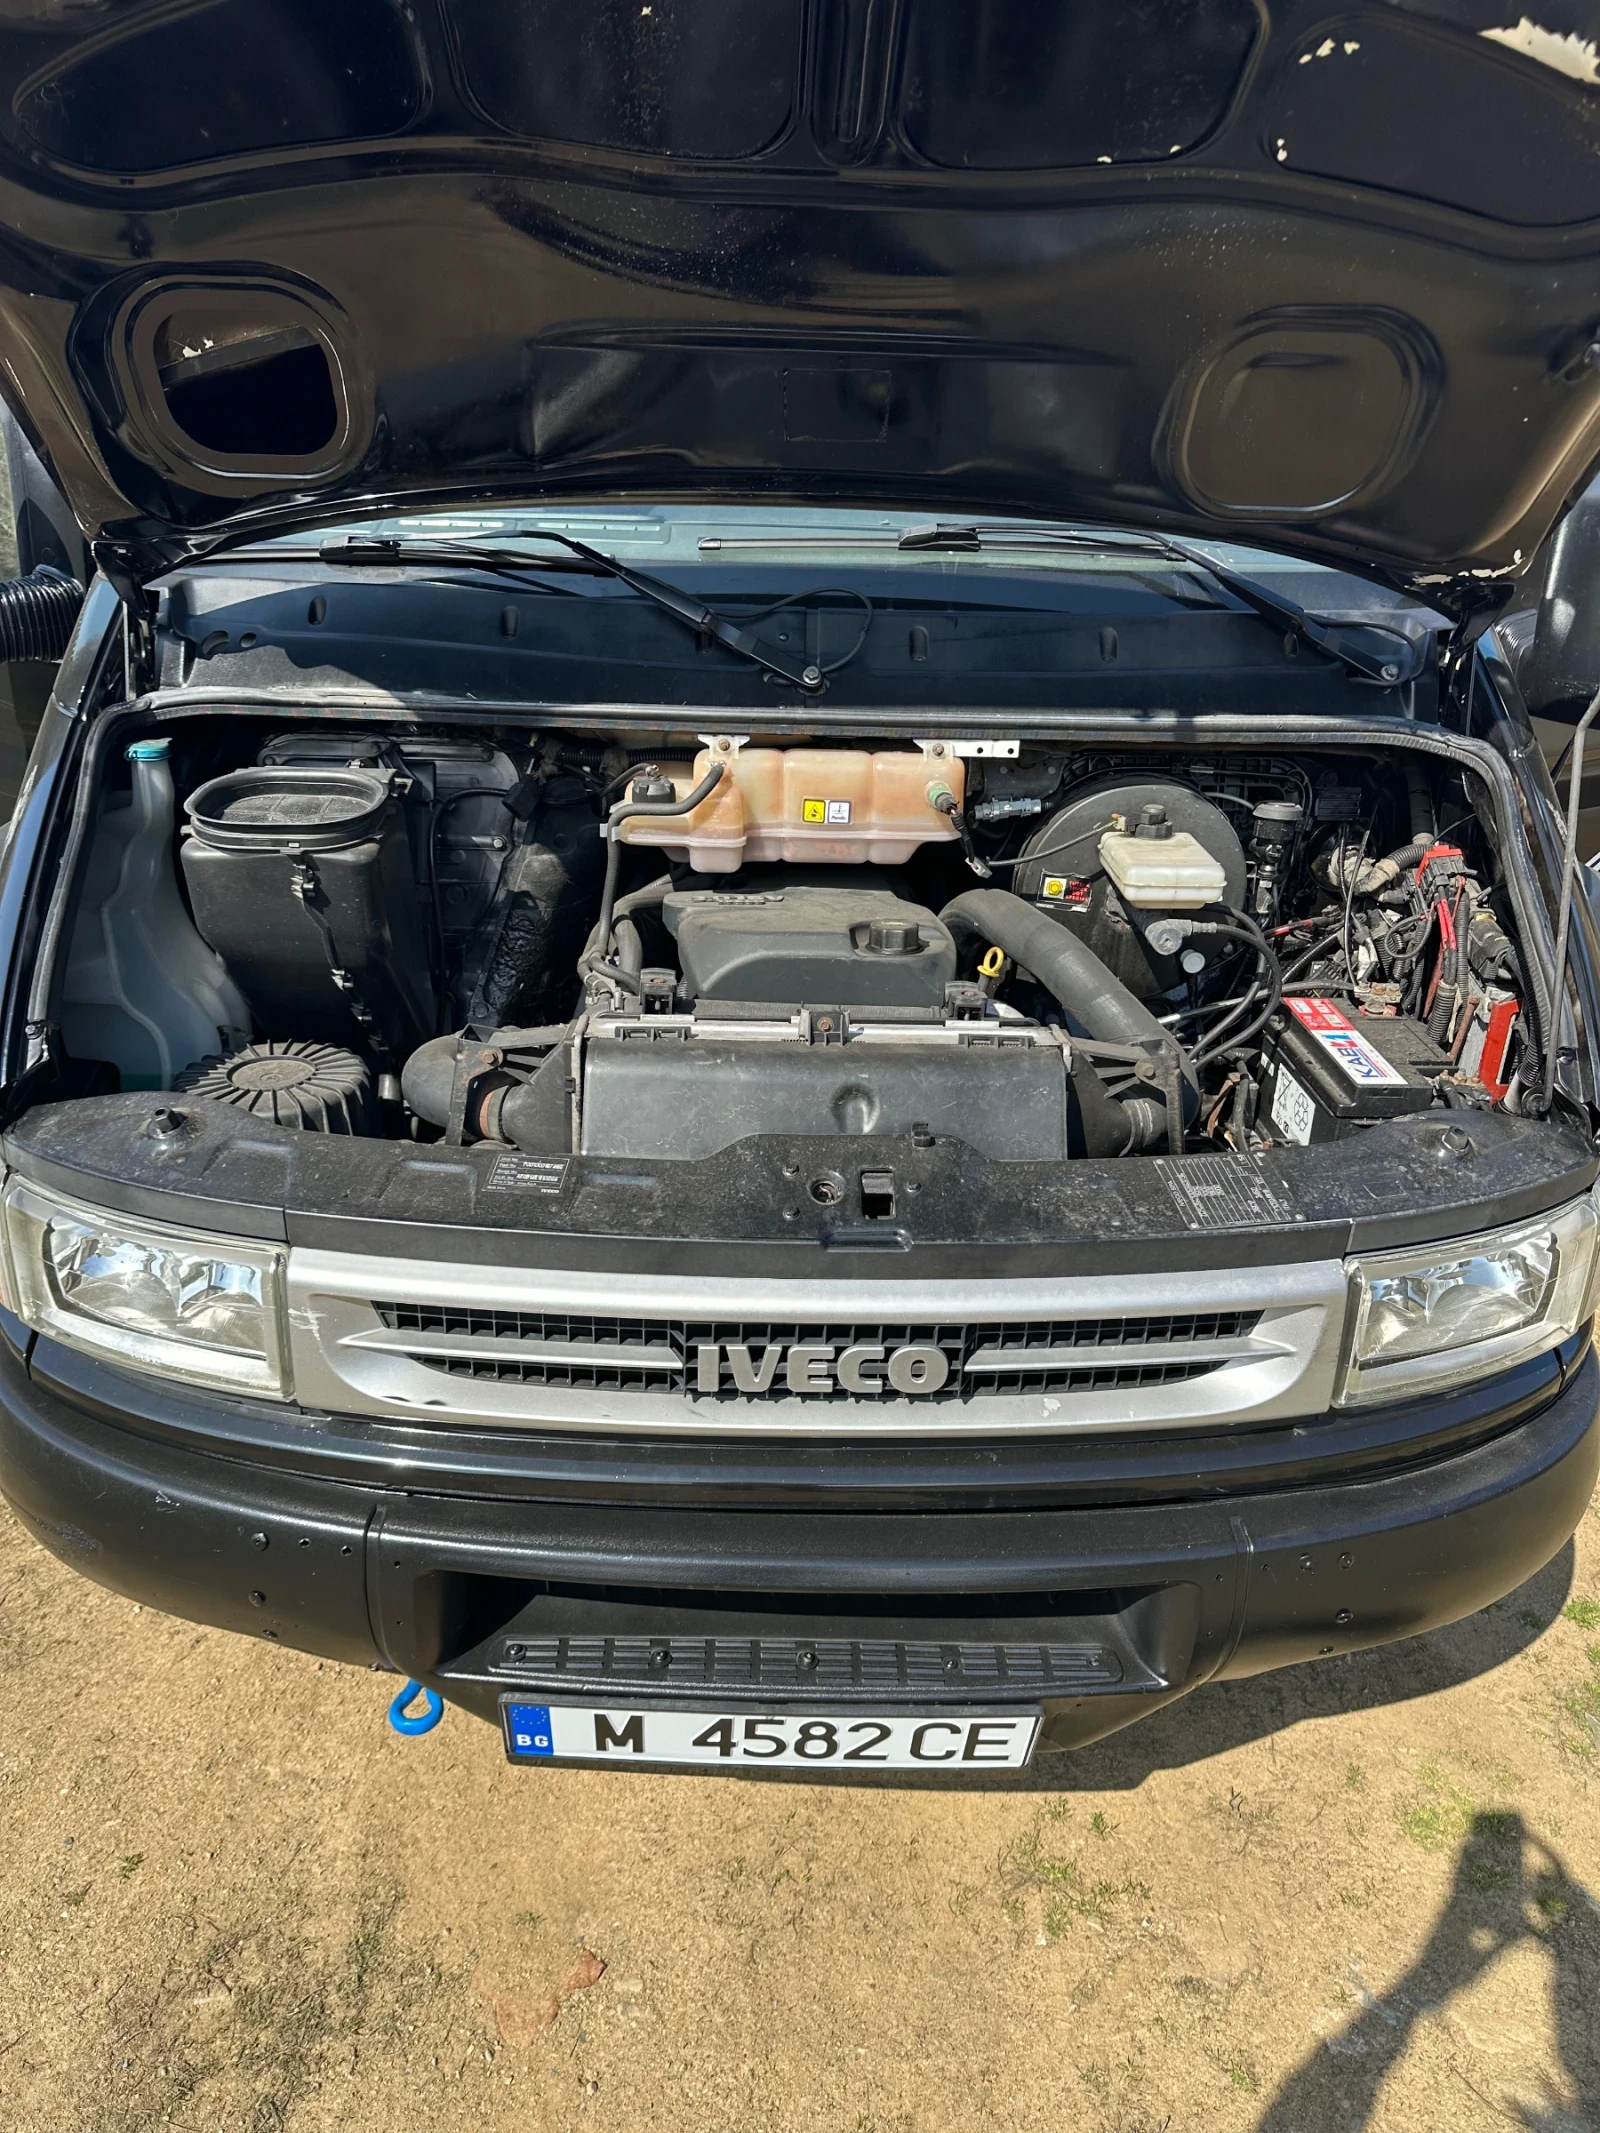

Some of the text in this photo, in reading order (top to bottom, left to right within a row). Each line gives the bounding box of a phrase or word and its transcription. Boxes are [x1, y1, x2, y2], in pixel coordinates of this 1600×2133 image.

[698, 1344, 949, 1394] IVECO
[516, 1713, 1017, 1761] BG M 4582 CE
